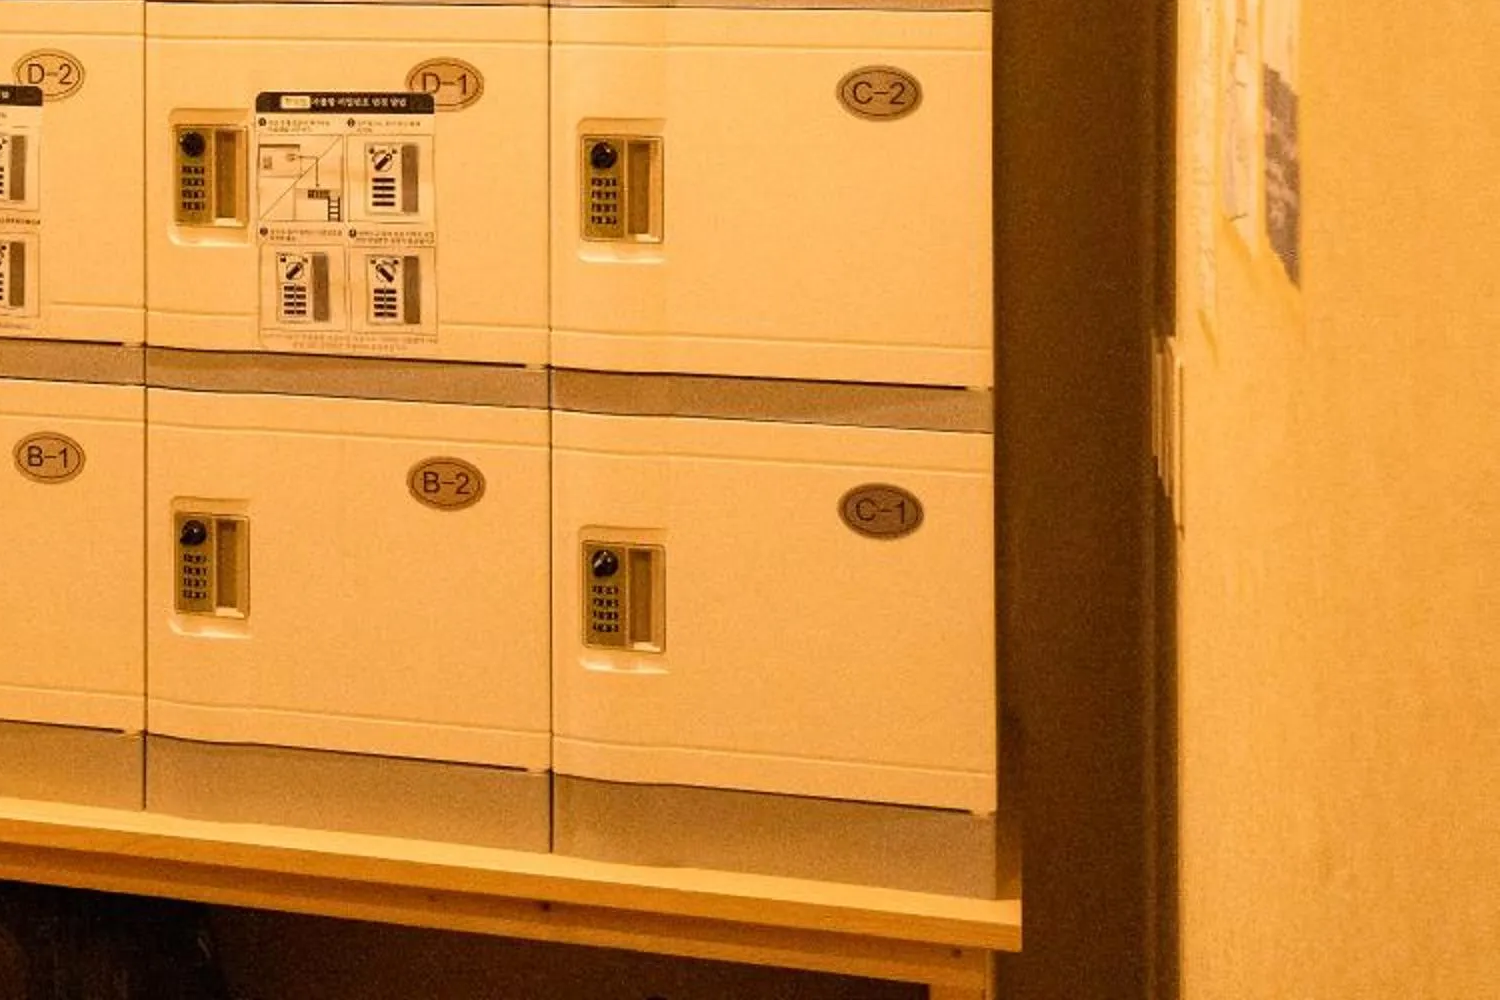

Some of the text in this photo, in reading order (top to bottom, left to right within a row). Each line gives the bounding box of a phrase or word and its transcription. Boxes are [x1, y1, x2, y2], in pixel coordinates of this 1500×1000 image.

[28, 63, 73, 85] D-2
[422, 72, 467, 96] D-1
[852, 79, 905, 105] C-2
[27, 445, 70, 469] B-1
[421, 471, 471, 496] B-2
[855, 498, 905, 524] C-1
